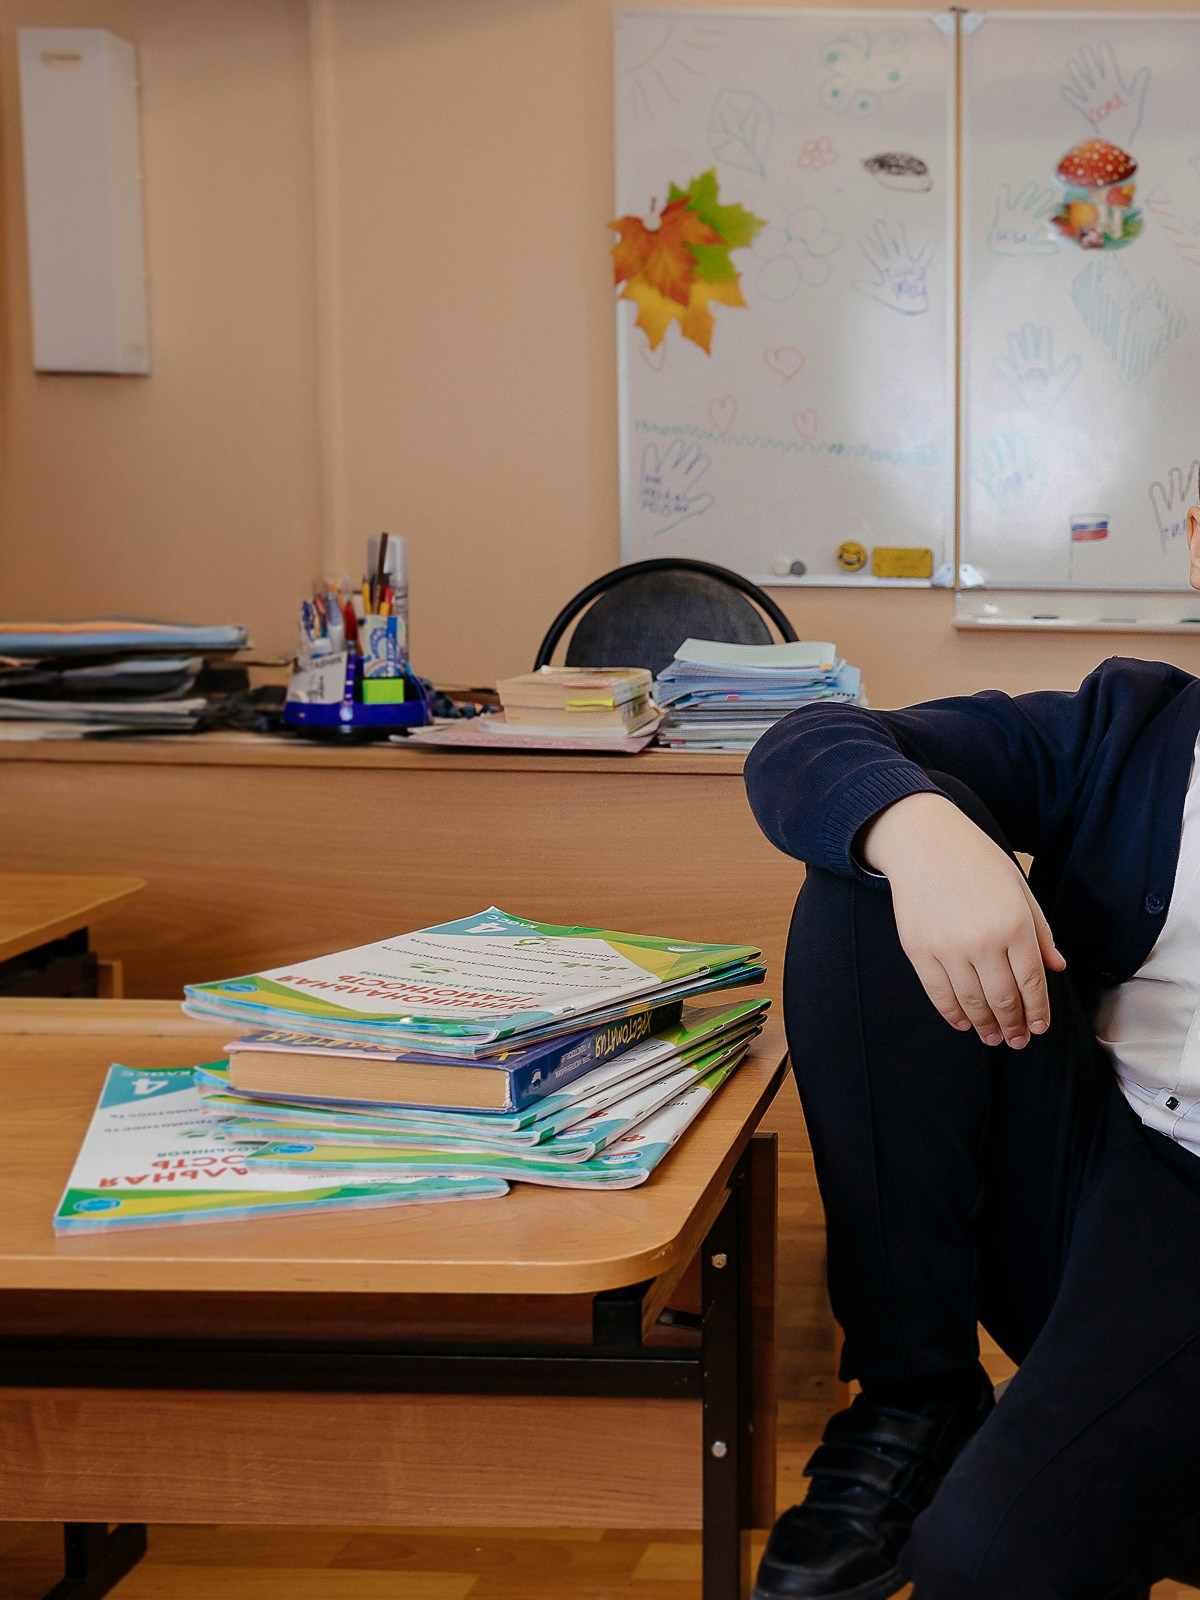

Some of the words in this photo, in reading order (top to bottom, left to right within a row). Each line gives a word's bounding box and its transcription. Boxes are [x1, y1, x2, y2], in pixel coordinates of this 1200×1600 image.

[463, 922, 508, 935] 4
[274, 975, 542, 1010] ФУНКЦИОНАЛЬНАЯ
[337, 974, 536, 1003] ГРАМОТНОСТЬ
[595, 1011, 653, 1058] ХРЕСТОМАТИЯ
[131, 1078, 169, 1096] 4
